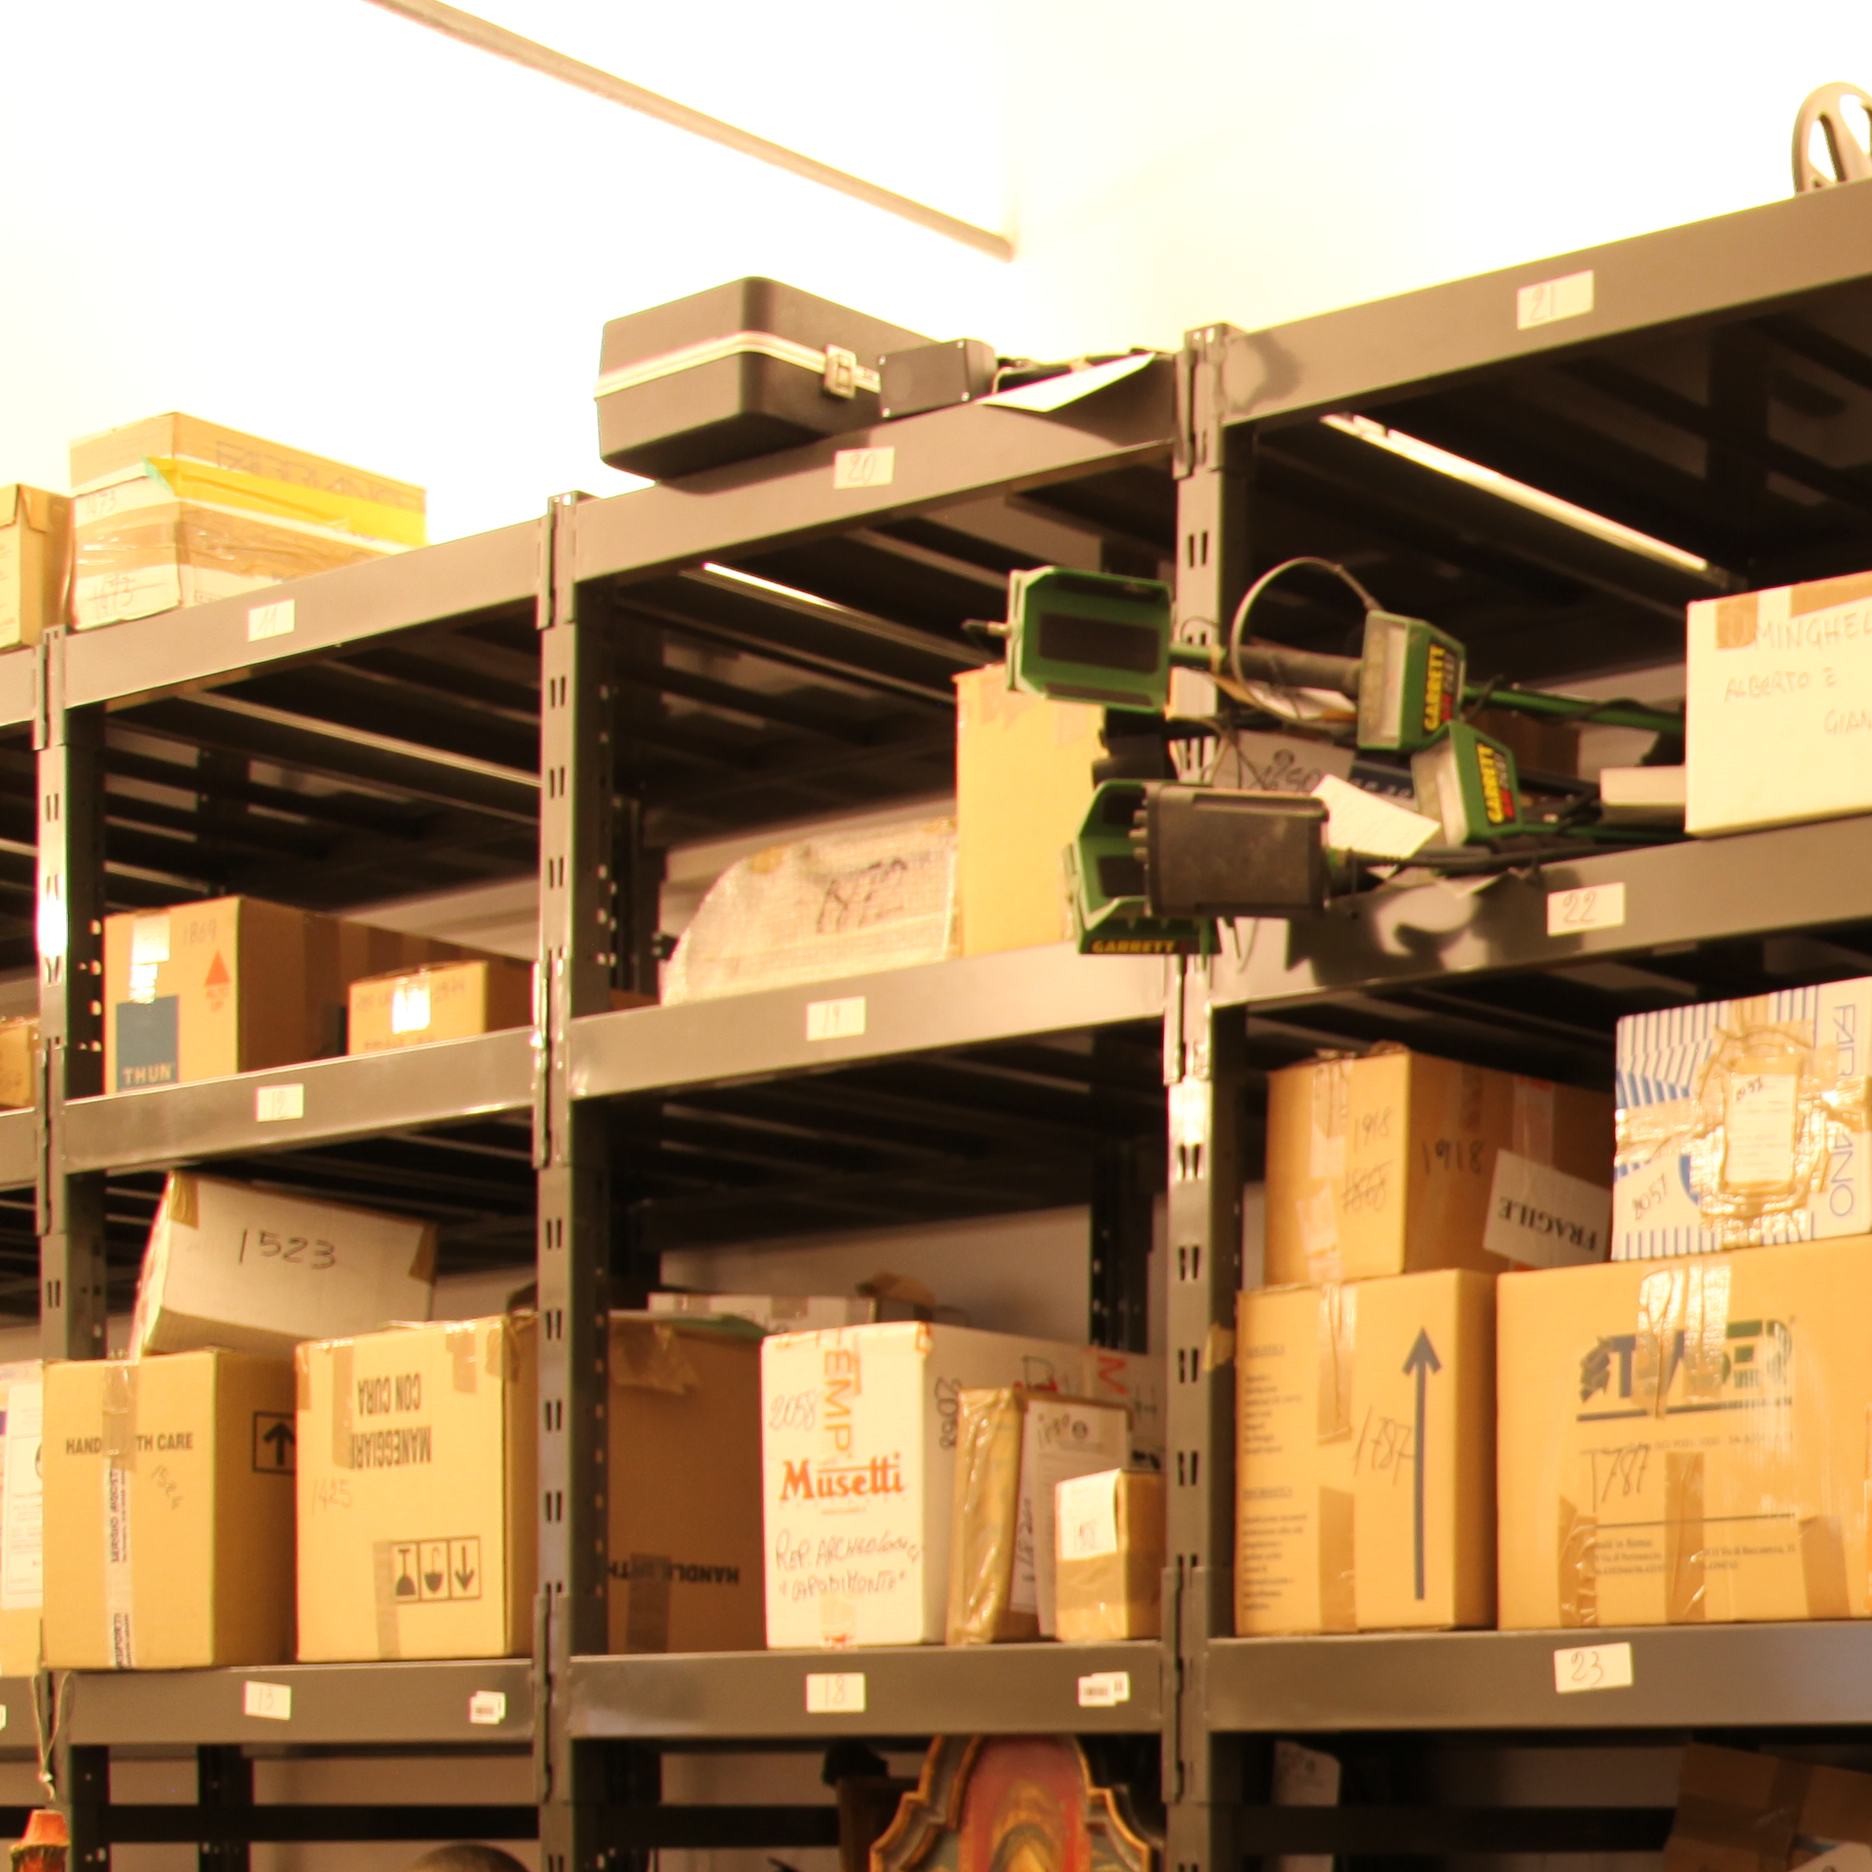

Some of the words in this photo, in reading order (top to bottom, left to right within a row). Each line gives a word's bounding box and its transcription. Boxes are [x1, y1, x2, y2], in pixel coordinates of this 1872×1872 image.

[1423, 644, 1447, 732] GARRETT
[1476, 741, 1505, 824] GARRETT
[1561, 888, 1598, 925] 22
[1092, 940, 1175, 954] GARRETT
[124, 1066, 172, 1086] THUN
[1421, 1141, 1484, 1176] 1918
[1497, 1195, 1598, 1253] FRAGILE
[239, 1229, 337, 1270] 1523
[357, 1376, 392, 1417] CURA
[396, 1373, 424, 1413] CON
[158, 1432, 194, 1452] CARE
[779, 1453, 906, 1502] Musetti
[1570, 1653, 1603, 1683] 23
